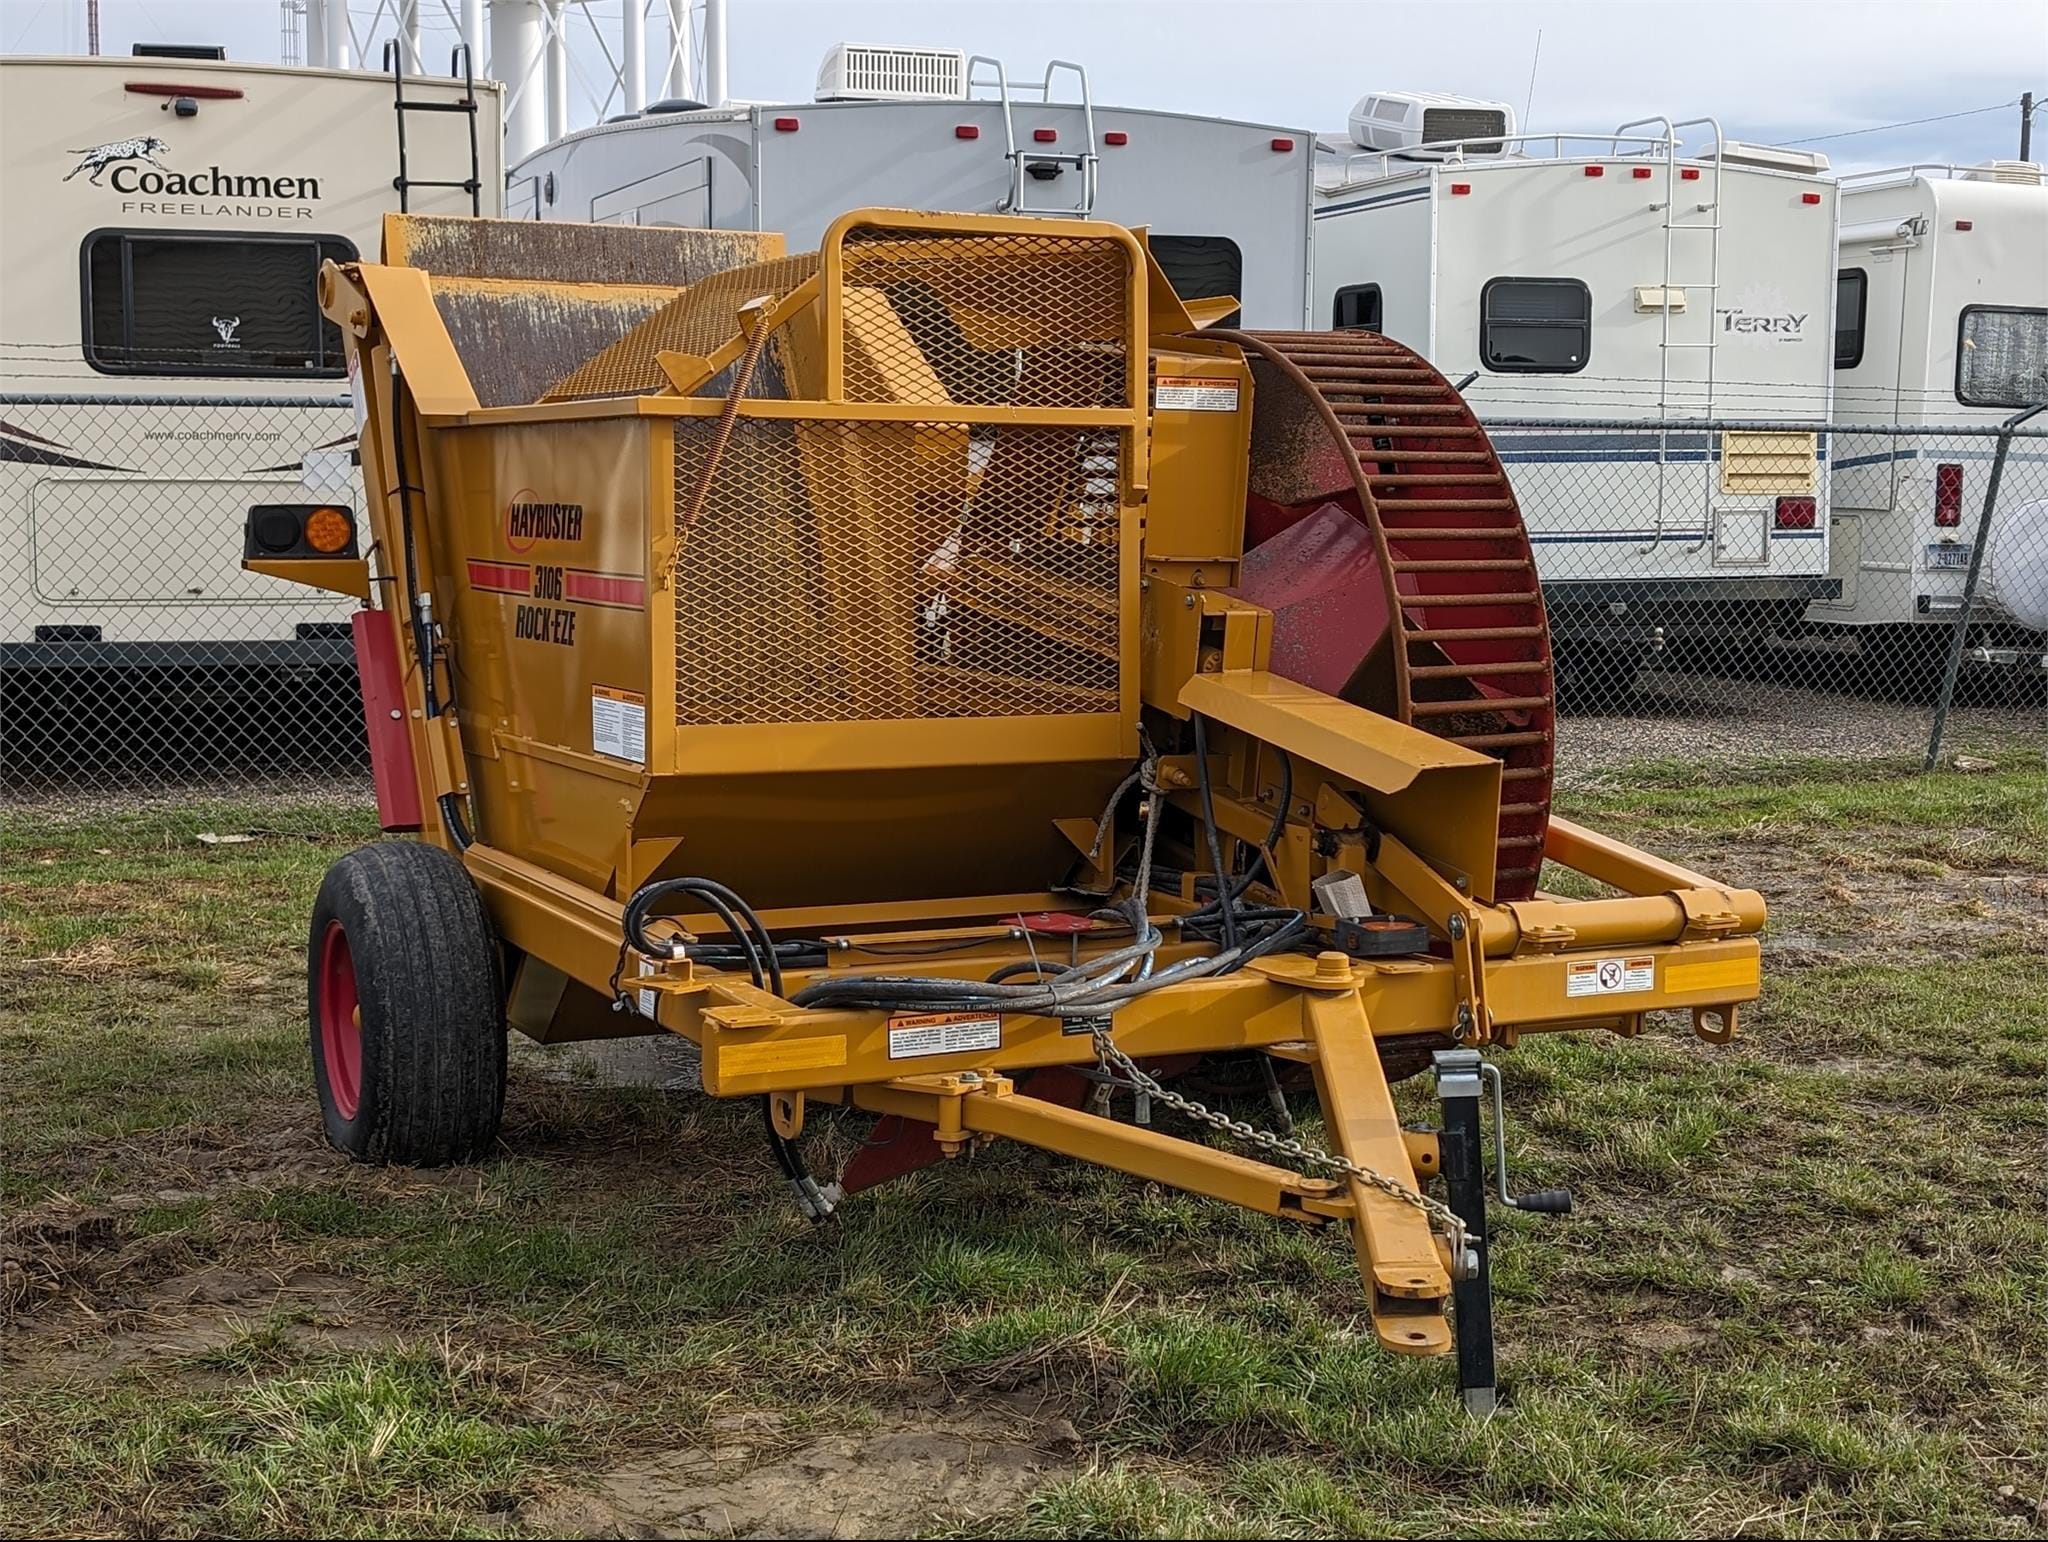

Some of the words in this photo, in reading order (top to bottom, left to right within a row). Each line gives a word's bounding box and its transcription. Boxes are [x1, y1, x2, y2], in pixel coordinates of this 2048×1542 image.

[111, 166, 322, 200] Coachmen
[122, 202, 313, 219] FREELANDER
[1716, 309, 1808, 333] TERRY
[144, 429, 281, 442] www.coachmenrv.com
[510, 502, 583, 541] HAYBUSTER
[534, 565, 563, 601] 3106
[515, 604, 576, 647] ROCK-EZE
[905, 1018, 936, 1026] WARNING
